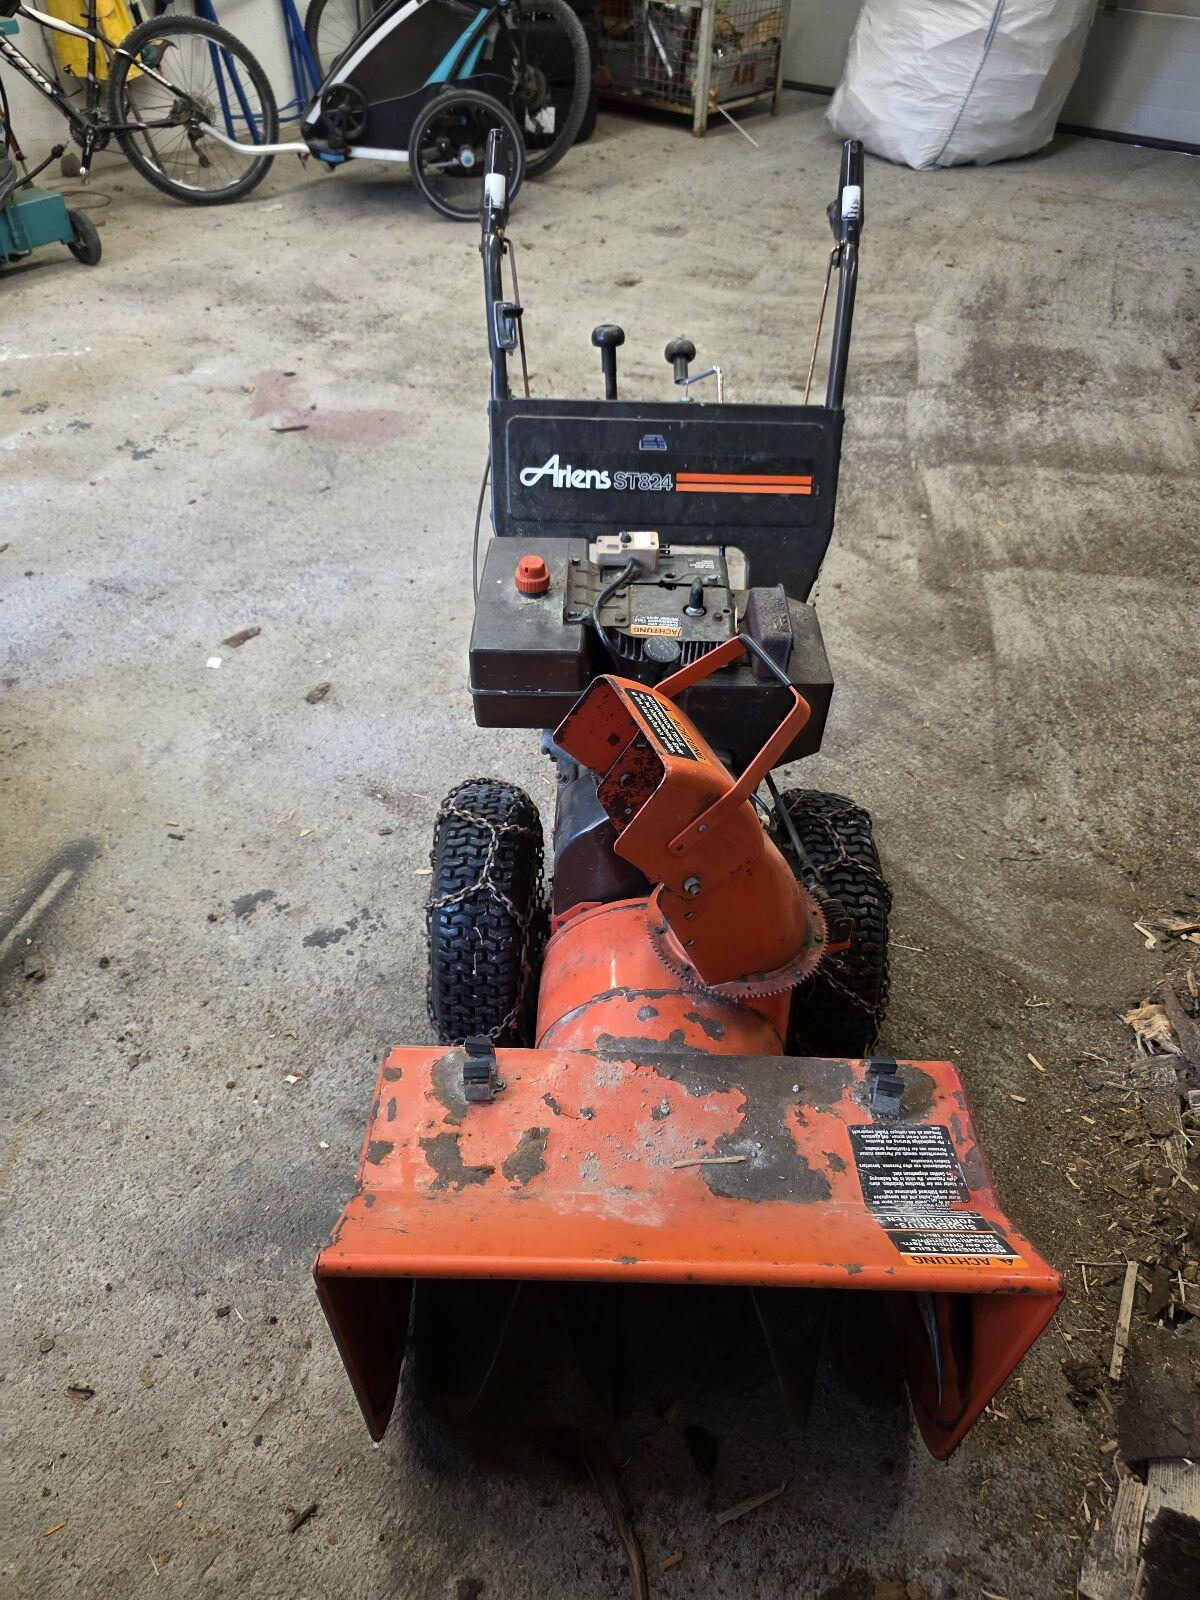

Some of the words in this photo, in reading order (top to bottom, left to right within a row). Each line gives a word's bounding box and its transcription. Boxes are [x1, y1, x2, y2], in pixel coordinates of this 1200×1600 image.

[519, 454, 611, 490] Ariens
[614, 471, 673, 491] ST824
[633, 627, 677, 635] ACHTUNG
[911, 1255, 990, 1266] ACHTUNG
